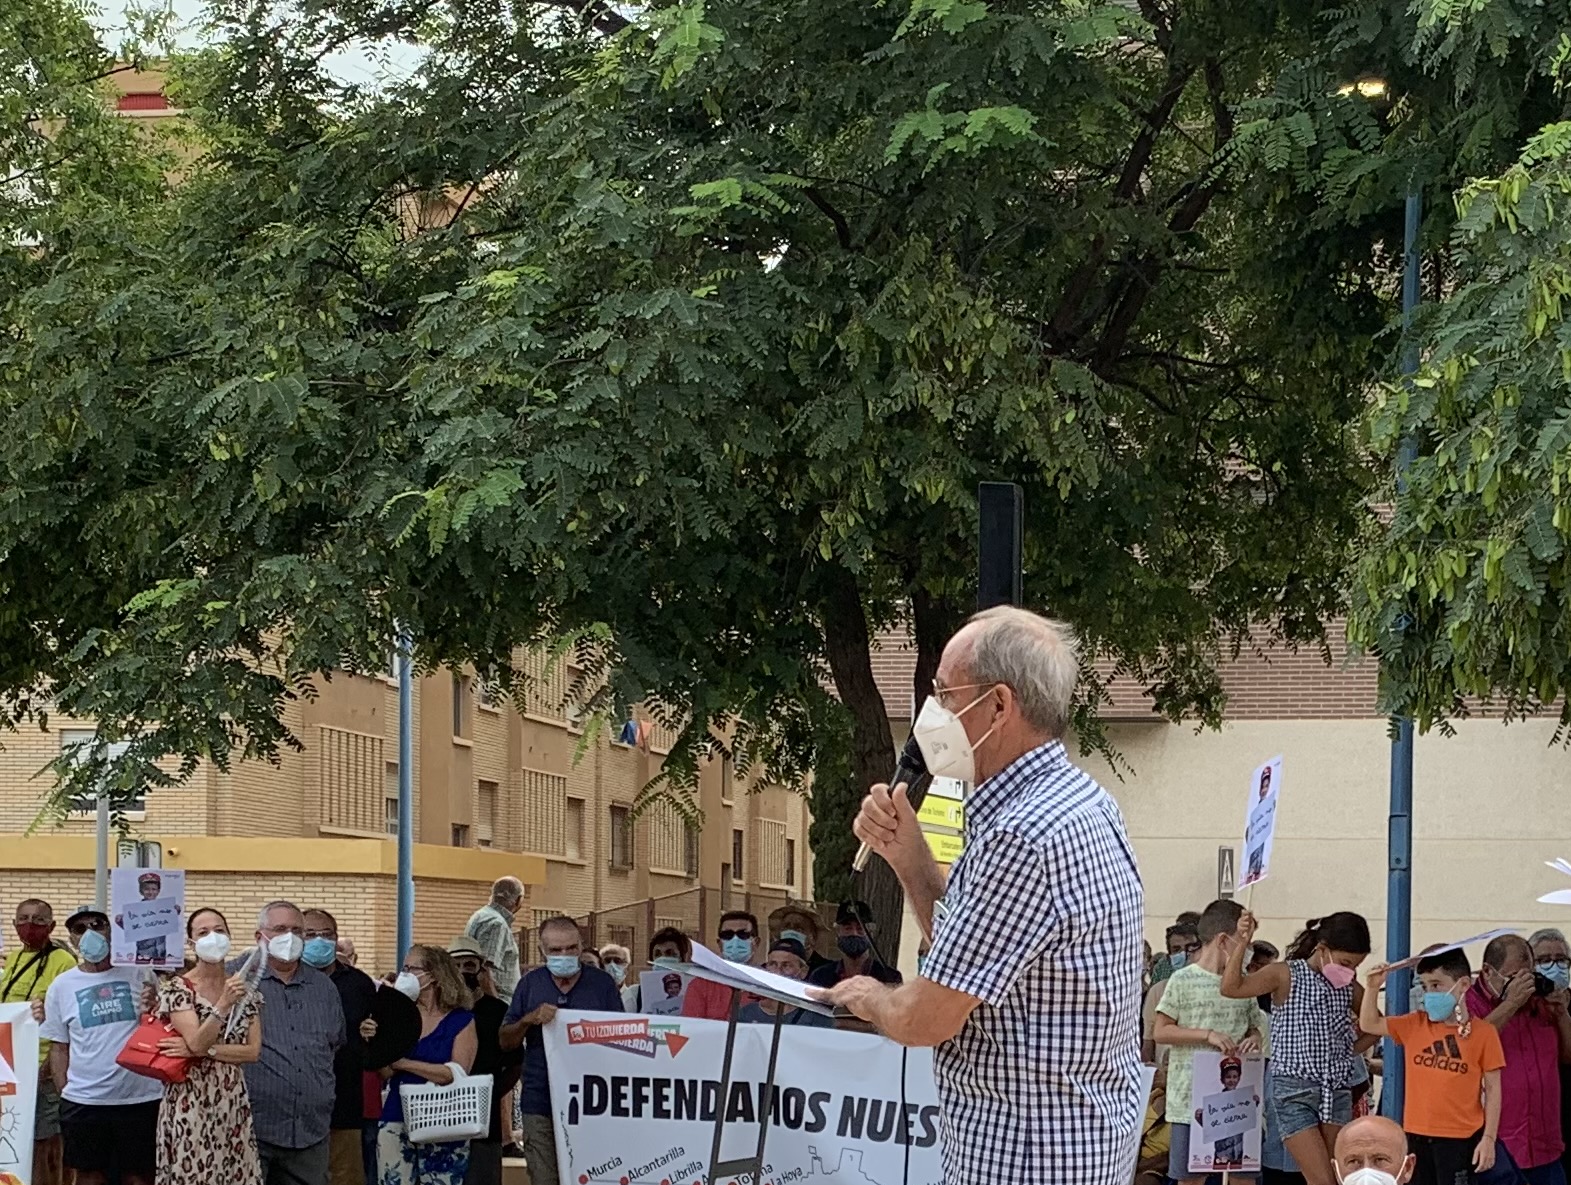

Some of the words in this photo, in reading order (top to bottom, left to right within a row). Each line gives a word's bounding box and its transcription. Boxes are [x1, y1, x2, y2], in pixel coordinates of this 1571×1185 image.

[91, 999, 121, 1011] AIRE
[91, 1007, 122, 1017] LIMPIO
[585, 1026, 595, 1038] TU
[596, 1023, 645, 1038] IZQUIERDA
[1413, 1054, 1468, 1074] adidas
[568, 1074, 832, 1133] ¡DEFENDAMOS
[586, 1156, 623, 1180] Murcia
[627, 1145, 686, 1181] Alcantarilla
[668, 1160, 704, 1185] Librilla
[781, 1167, 803, 1184] Hoya
